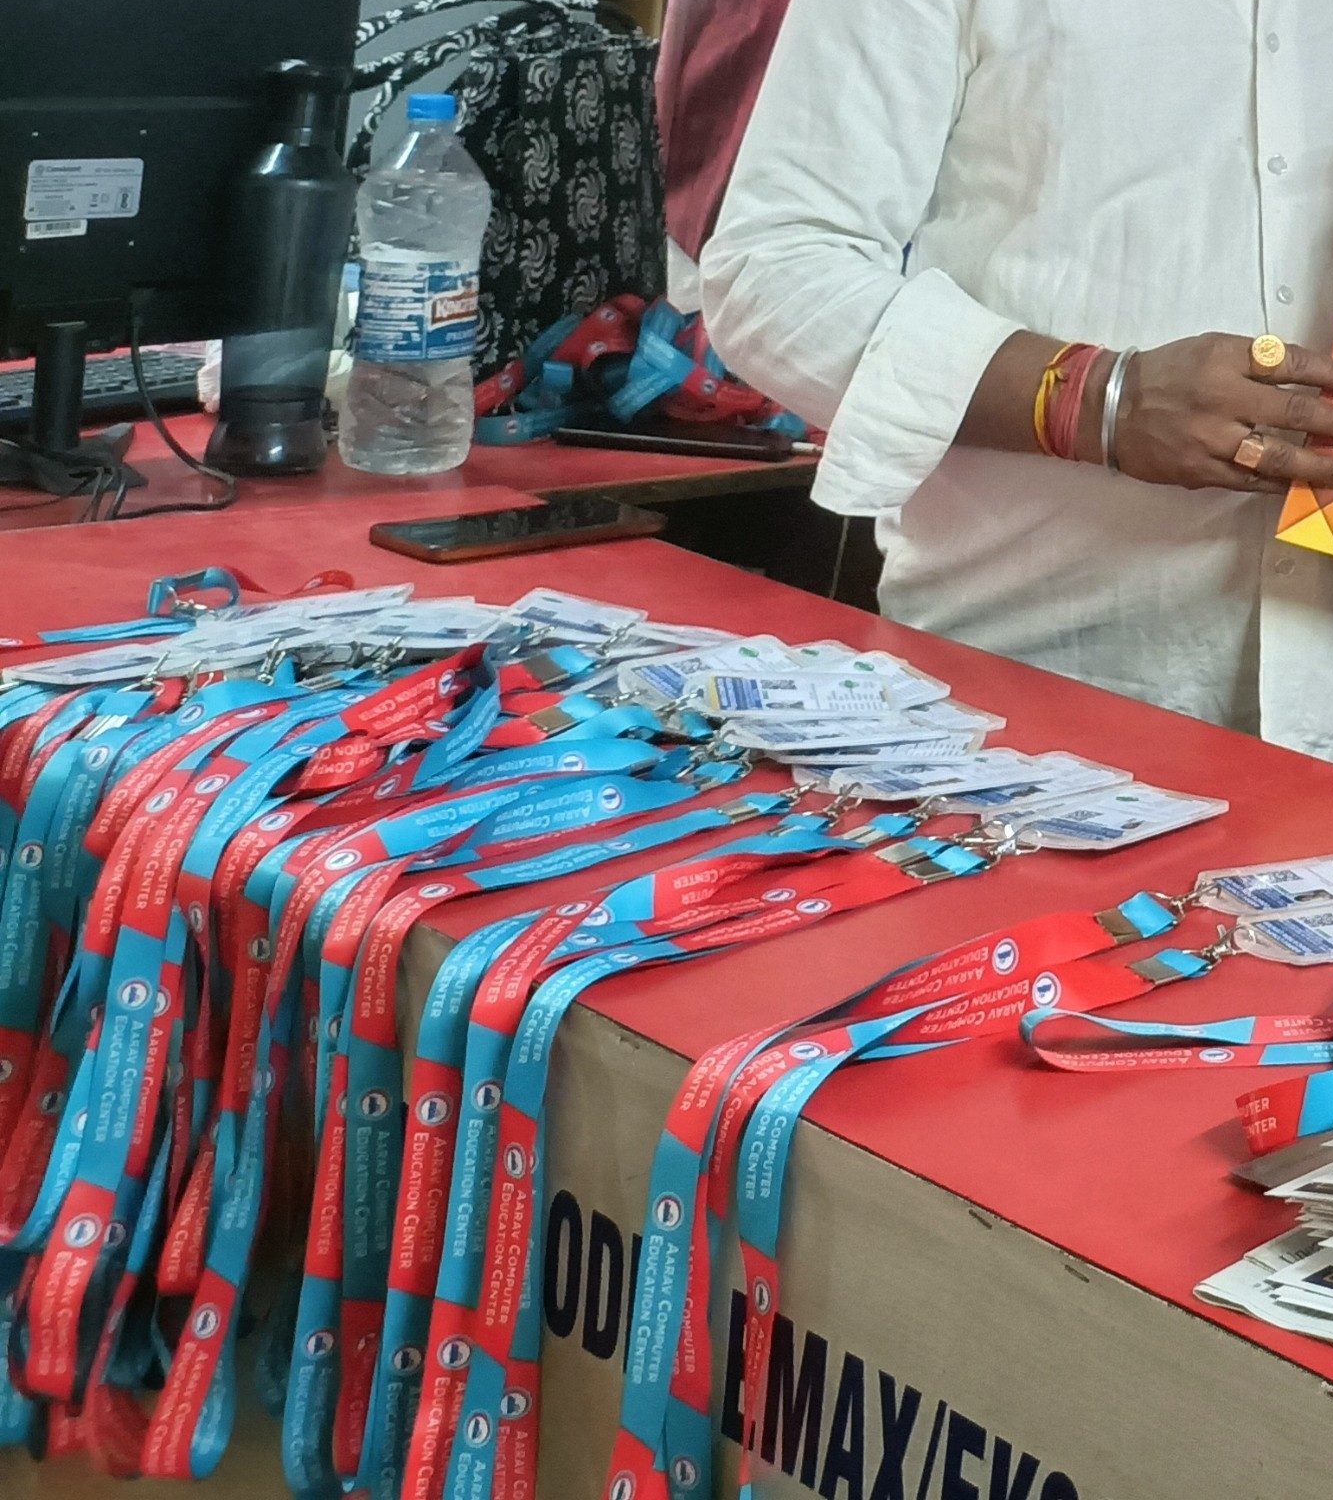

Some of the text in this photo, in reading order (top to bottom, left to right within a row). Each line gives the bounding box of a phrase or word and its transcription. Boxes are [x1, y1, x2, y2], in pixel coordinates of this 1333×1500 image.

[400, 1132, 430, 1269] EDUCATION CENTER
[452, 1119, 484, 1258] EDUCATION CENTER
[745, 1140, 765, 1201] CENTER
[759, 1116, 788, 1199] COMPUTER
[485, 1262, 503, 1326] CENTER
[499, 1189, 527, 1324] AARAV COMPUTER
[631, 1234, 664, 1385] EDUCATION CENTER
[649, 1242, 680, 1382] AARAV COMPUTER
